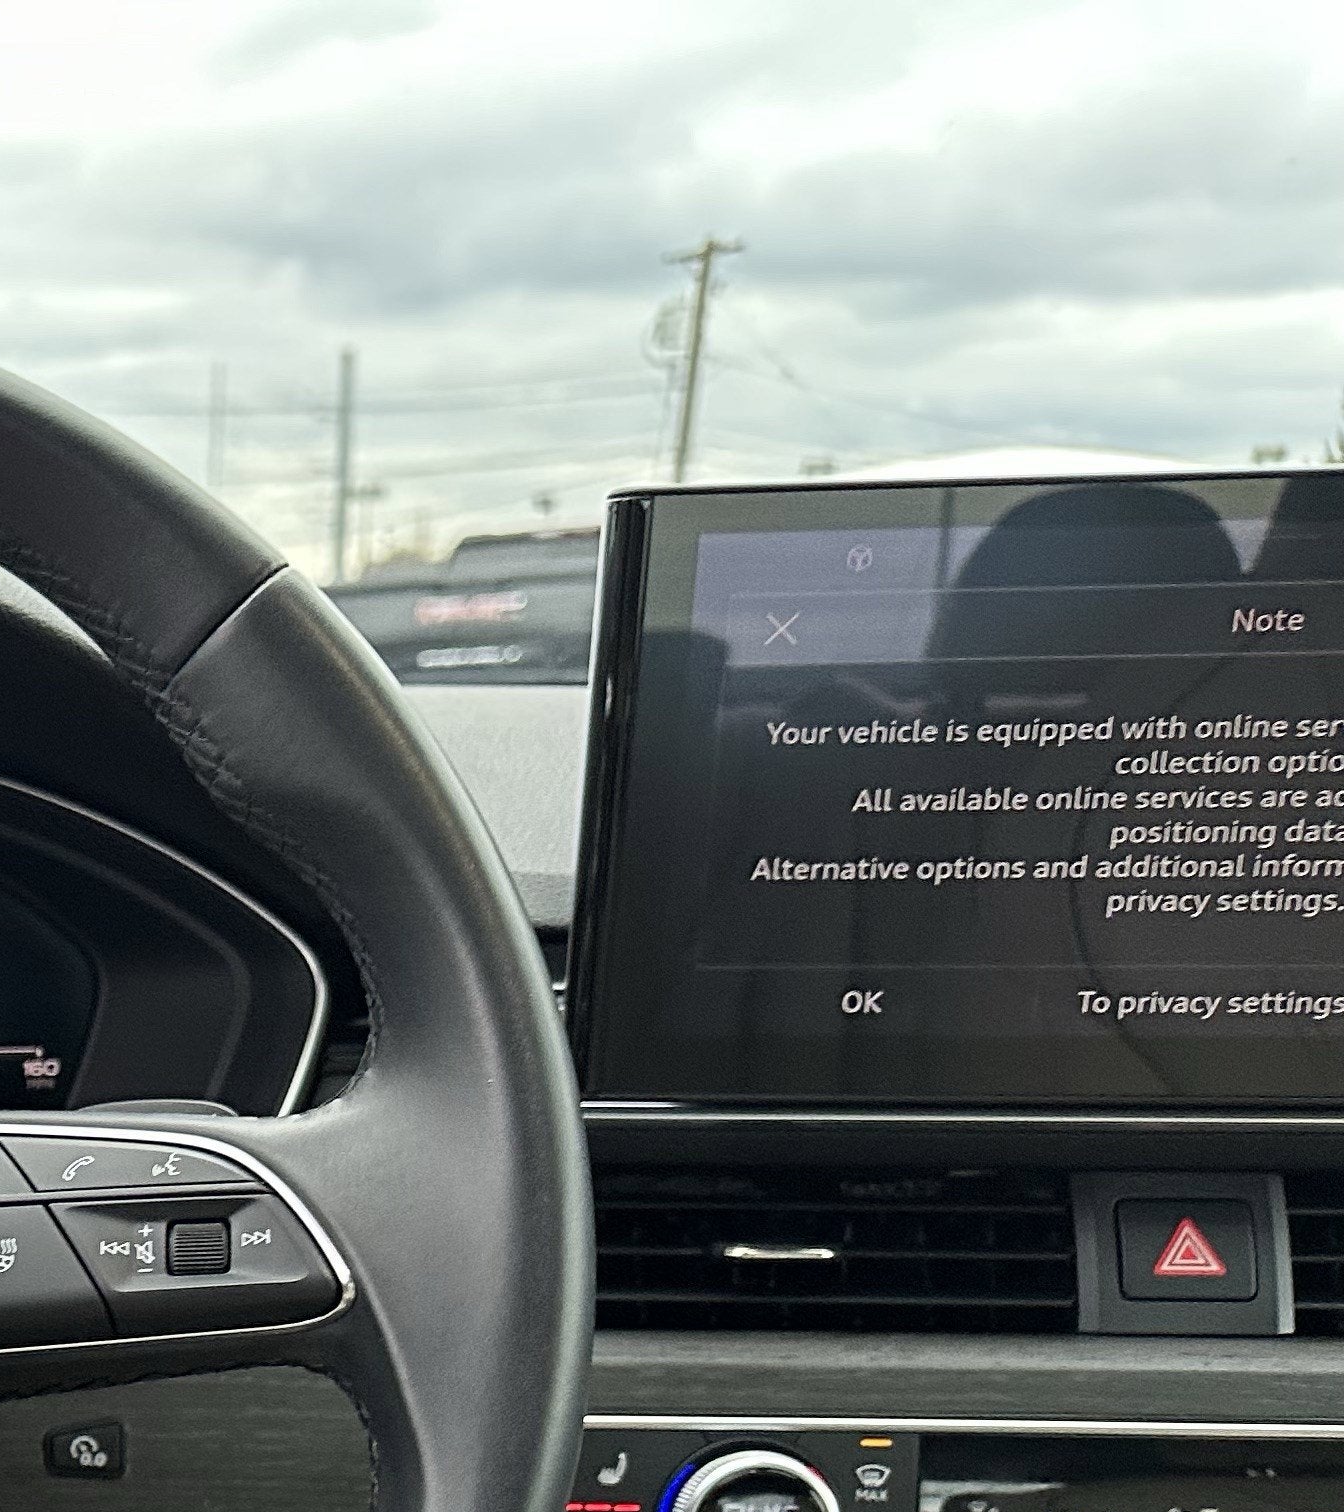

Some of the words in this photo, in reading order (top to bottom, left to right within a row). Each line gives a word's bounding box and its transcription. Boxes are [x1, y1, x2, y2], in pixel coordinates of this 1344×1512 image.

[1231, 609, 1307, 635] Note
[767, 721, 832, 745] Your
[838, 718, 938, 744] vehicle
[945, 719, 969, 743] is
[976, 716, 1114, 748] equipped
[1121, 715, 1187, 740] with
[1194, 714, 1288, 739] online
[1115, 750, 1260, 775] collection
[851, 788, 892, 812] All
[899, 786, 1029, 811] available
[1035, 785, 1127, 810] online
[1134, 785, 1253, 809] services
[1260, 788, 1308, 808] are
[1110, 820, 1277, 850] positioning
[1284, 819, 1344, 843] data
[750, 857, 910, 881] Alternative
[916, 856, 1025, 885] options
[1033, 854, 1088, 879] and
[1095, 854, 1246, 878] additional
[1106, 889, 1211, 918] privacy
[841, 990, 883, 1014] OK
[1078, 991, 1110, 1013] To
[1117, 990, 1220, 1020] privacy
[1227, 991, 1344, 1020] settings
